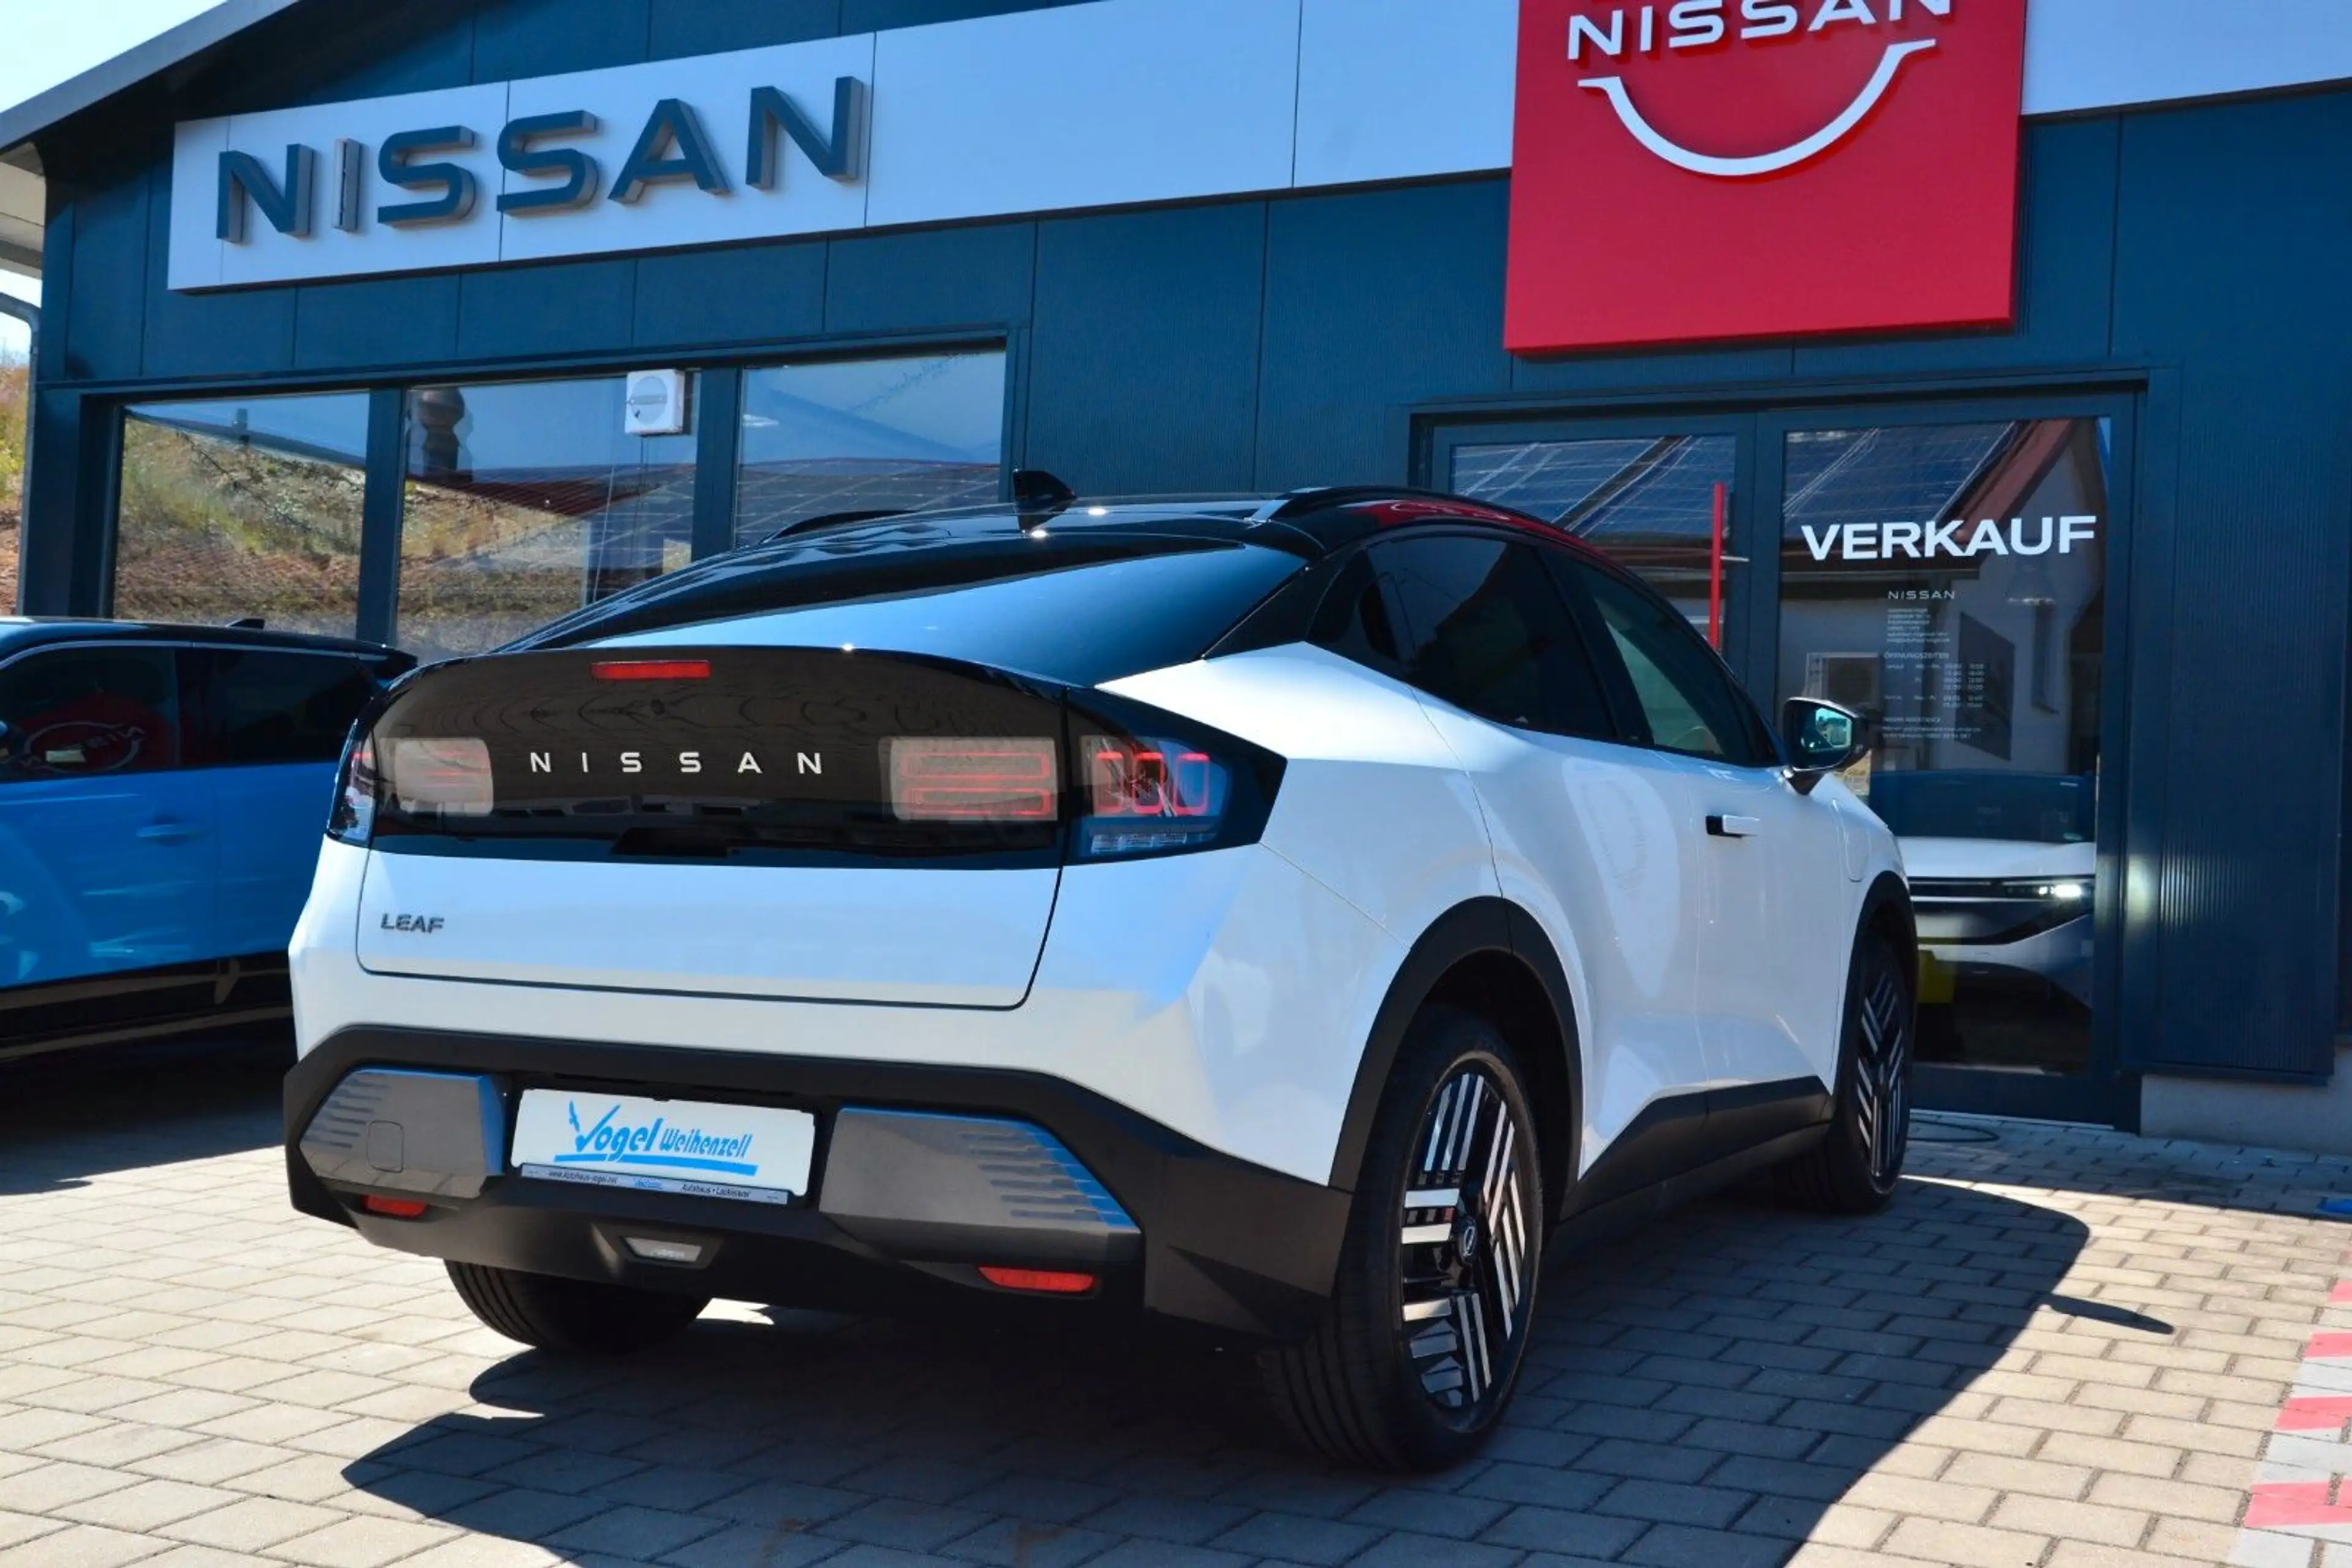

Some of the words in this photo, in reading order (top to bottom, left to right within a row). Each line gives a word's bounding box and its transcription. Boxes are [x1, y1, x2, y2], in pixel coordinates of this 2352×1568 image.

[217, 75, 864, 244] NISSAN
[1801, 516, 2097, 560] VERKAUF
[1888, 590, 1956, 600] NISSAN
[531, 752, 822, 775] NISSAN
[380, 913, 445, 935] LEAF
[569, 1101, 663, 1162] Vogel
[661, 1128, 753, 1158] Weihenzell
